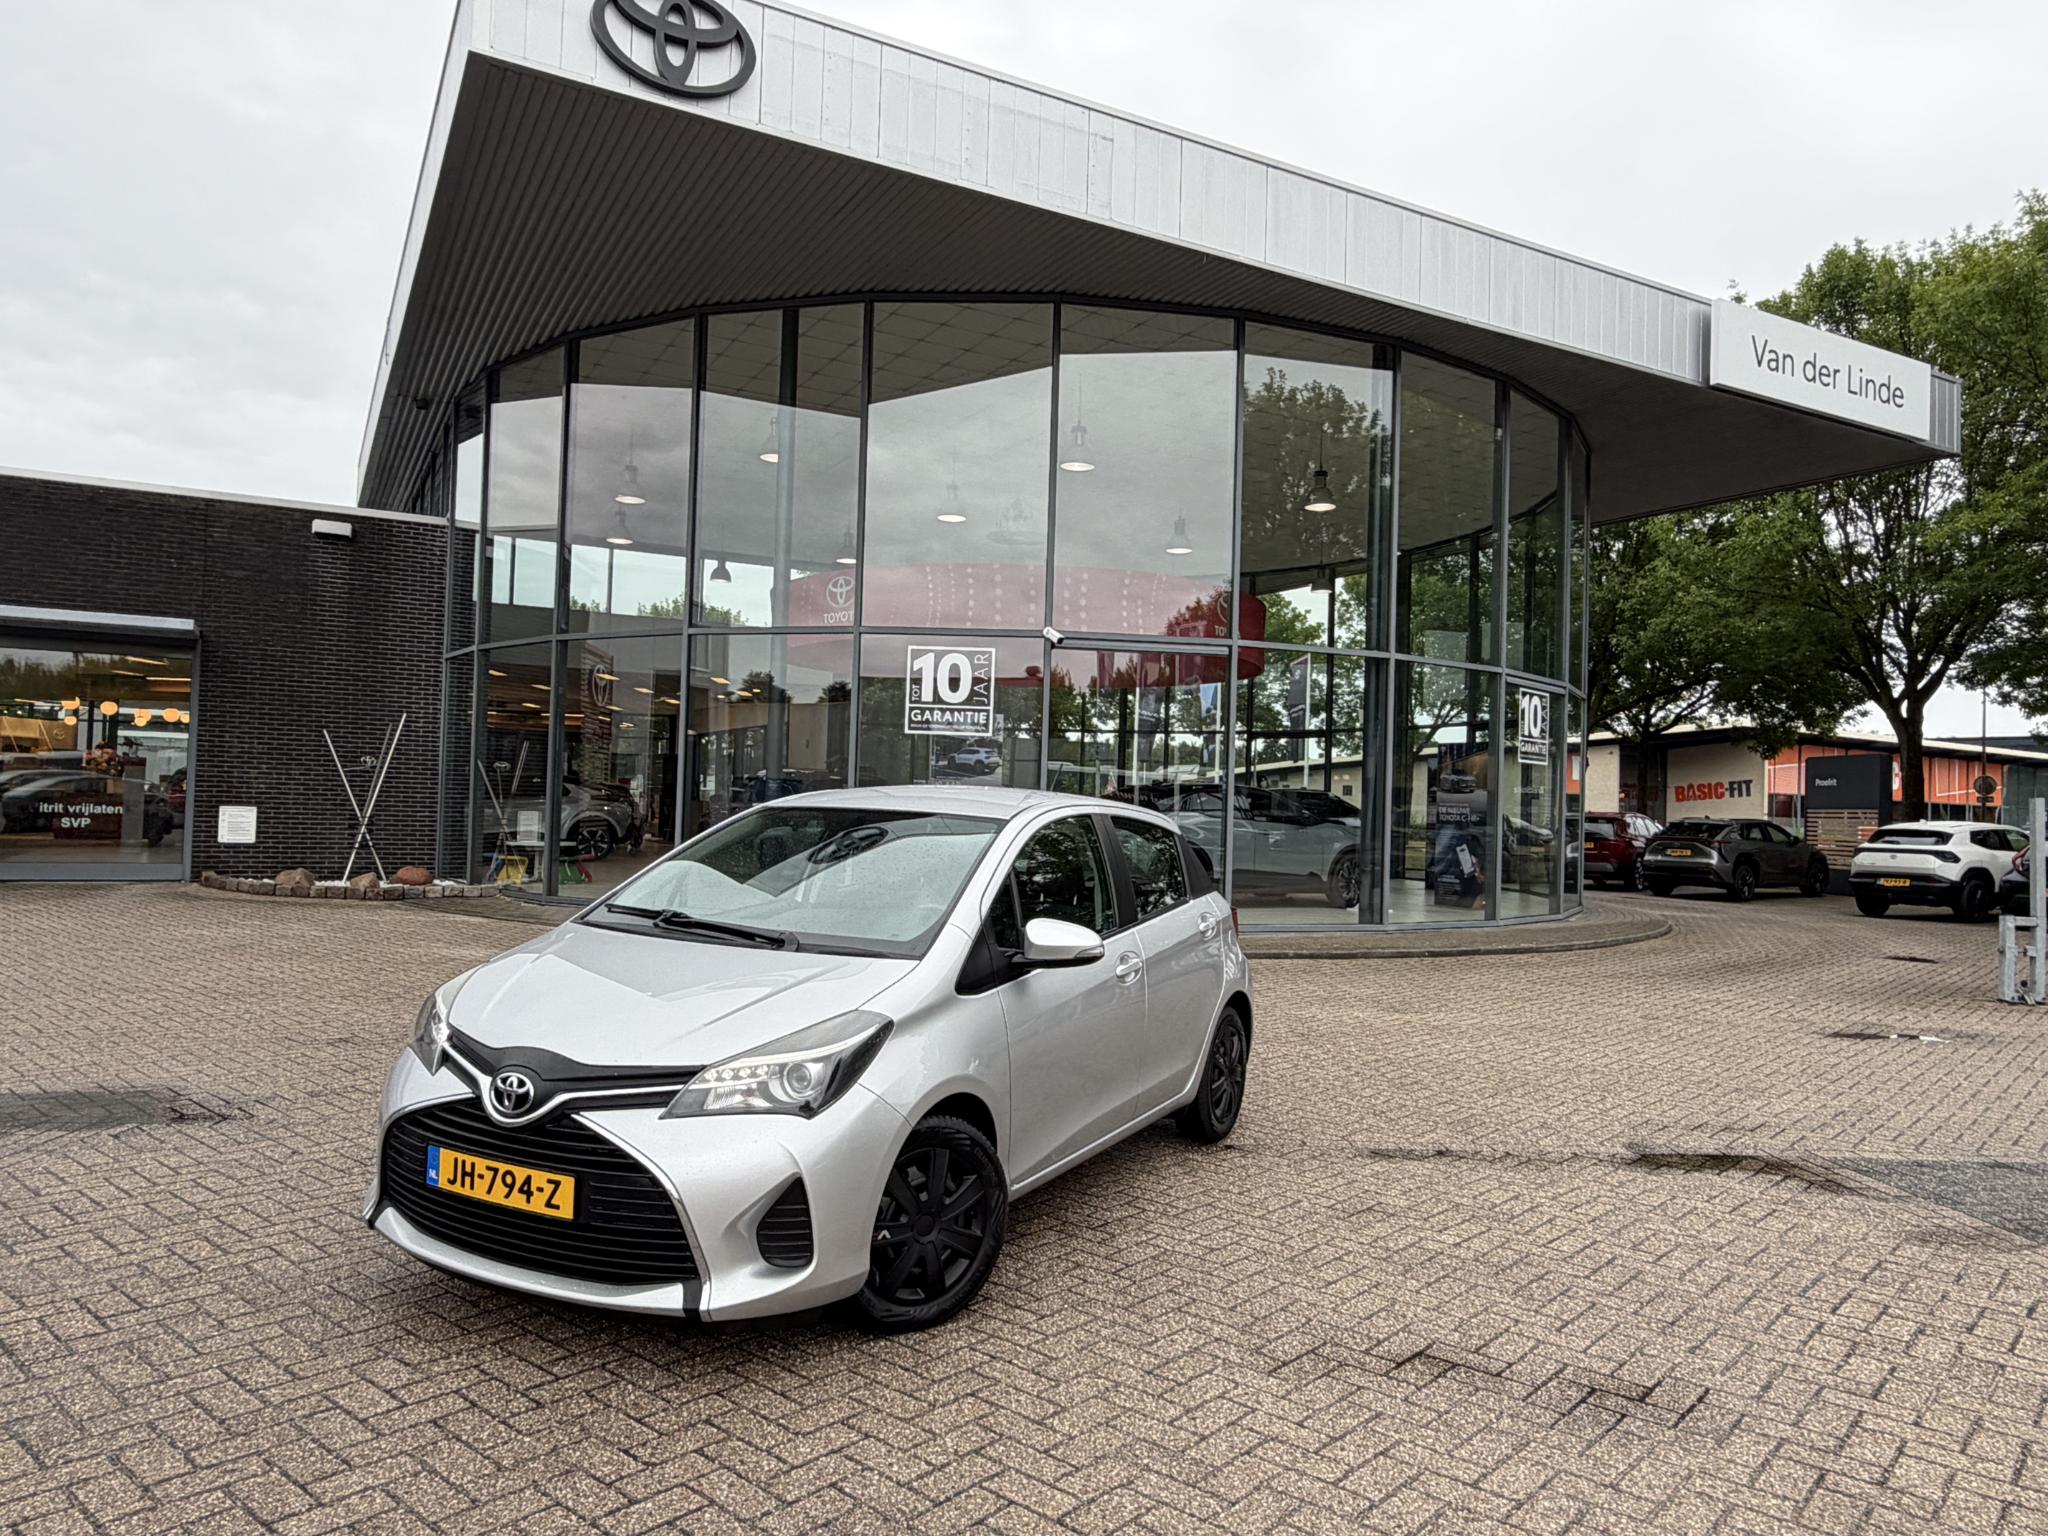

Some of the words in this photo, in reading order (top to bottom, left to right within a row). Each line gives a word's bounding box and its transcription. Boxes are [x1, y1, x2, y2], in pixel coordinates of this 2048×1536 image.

[1752, 335, 1795, 377] Van
[1803, 352, 1840, 390] der
[1847, 364, 1905, 408] Linde
[823, 610, 854, 624] TOYOT
[913, 652, 972, 703] 10
[973, 653, 989, 704] JAAR
[911, 684, 920, 701] TOT
[910, 709, 988, 724] GARANTIE
[1521, 694, 1541, 737] 10
[1675, 780, 1753, 802] BASIC-FIT
[67, 803, 123, 816] vrijlaten
[60, 817, 91, 828] SVP
[447, 1157, 562, 1210] JH-794-Z
